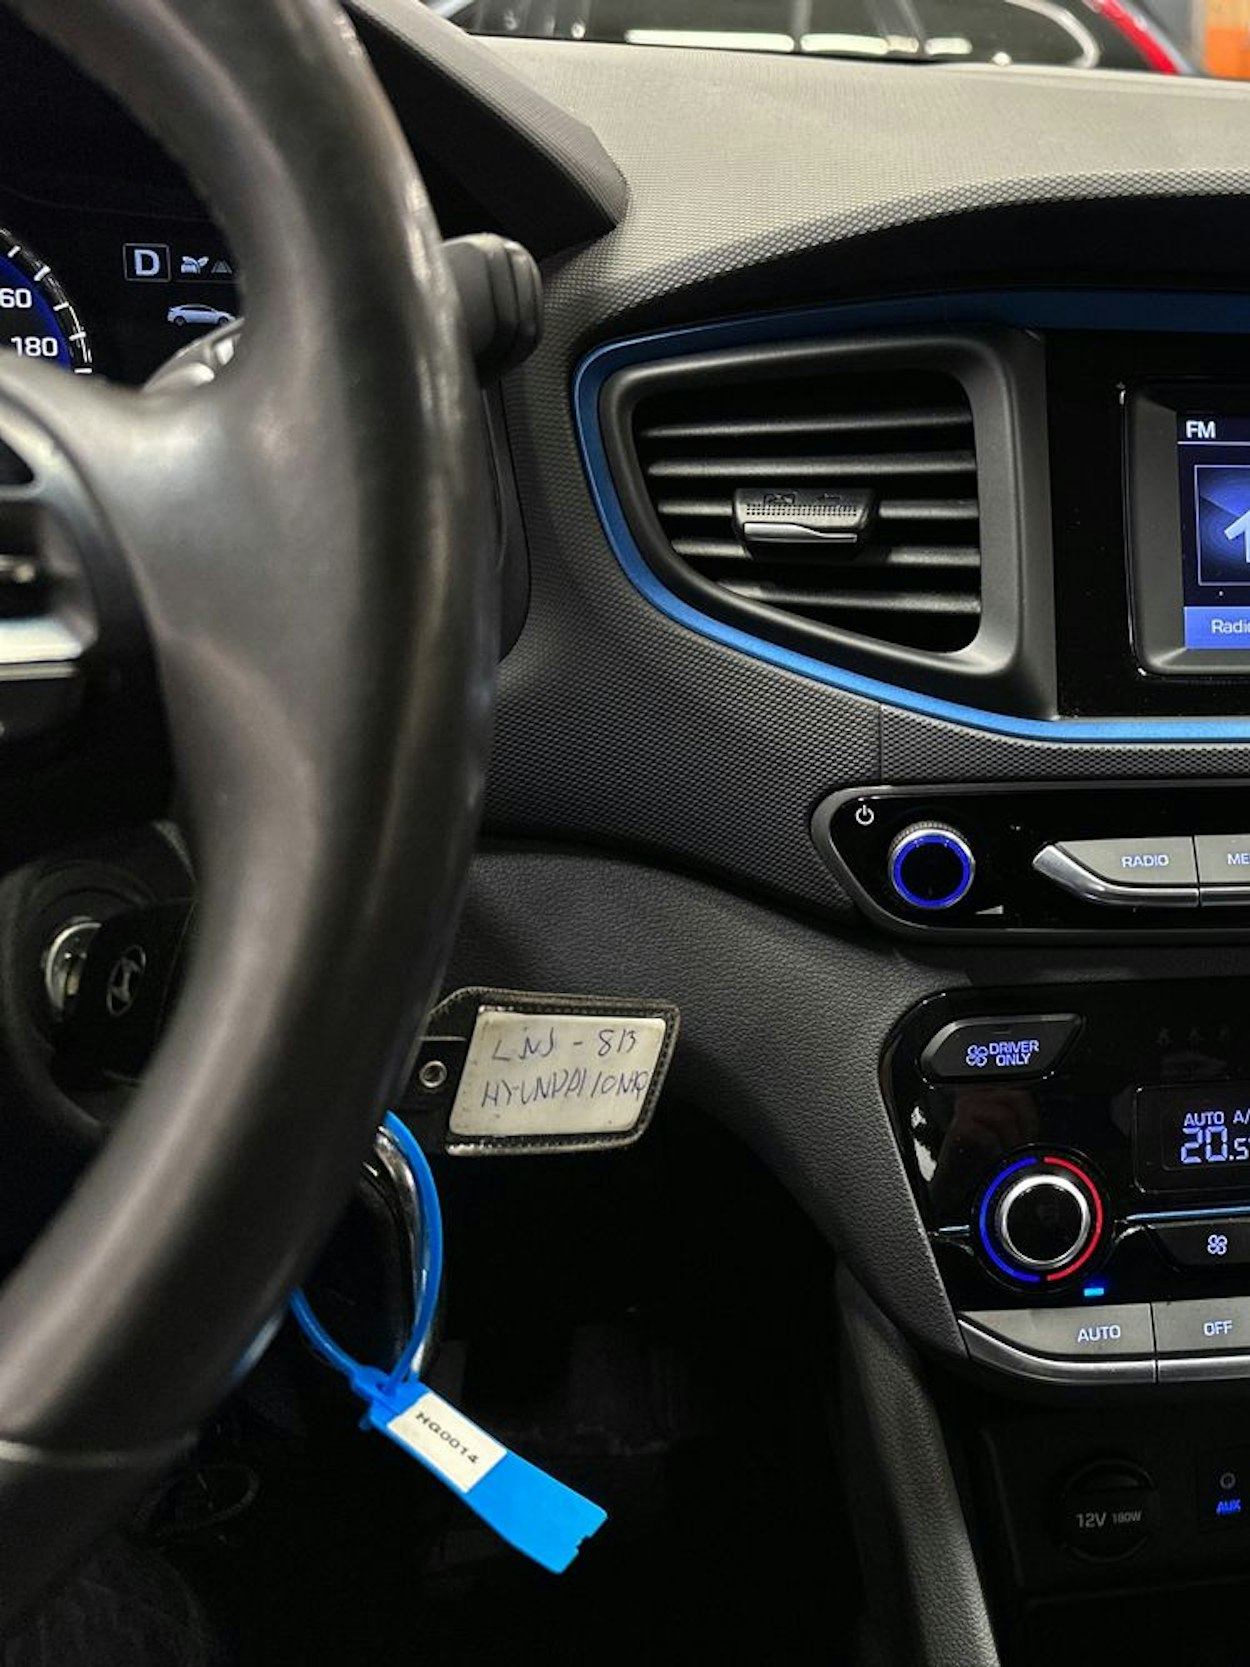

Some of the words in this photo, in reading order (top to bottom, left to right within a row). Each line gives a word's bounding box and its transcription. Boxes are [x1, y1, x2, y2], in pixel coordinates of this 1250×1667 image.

[134, 248, 161, 277] D
[11, 336, 59, 357] 180
[1186, 421, 1216, 439] FM
[1121, 854, 1170, 868] RADIO
[989, 1041, 1040, 1055] DRIVER
[995, 1053, 1032, 1067] ONLY
[1184, 1111, 1225, 1127] AUTO
[1077, 1325, 1121, 1342] AUTO
[1204, 1320, 1233, 1336] OFF
[1216, 1499, 1241, 1514] AUX
[1075, 1512, 1107, 1529] 12V
